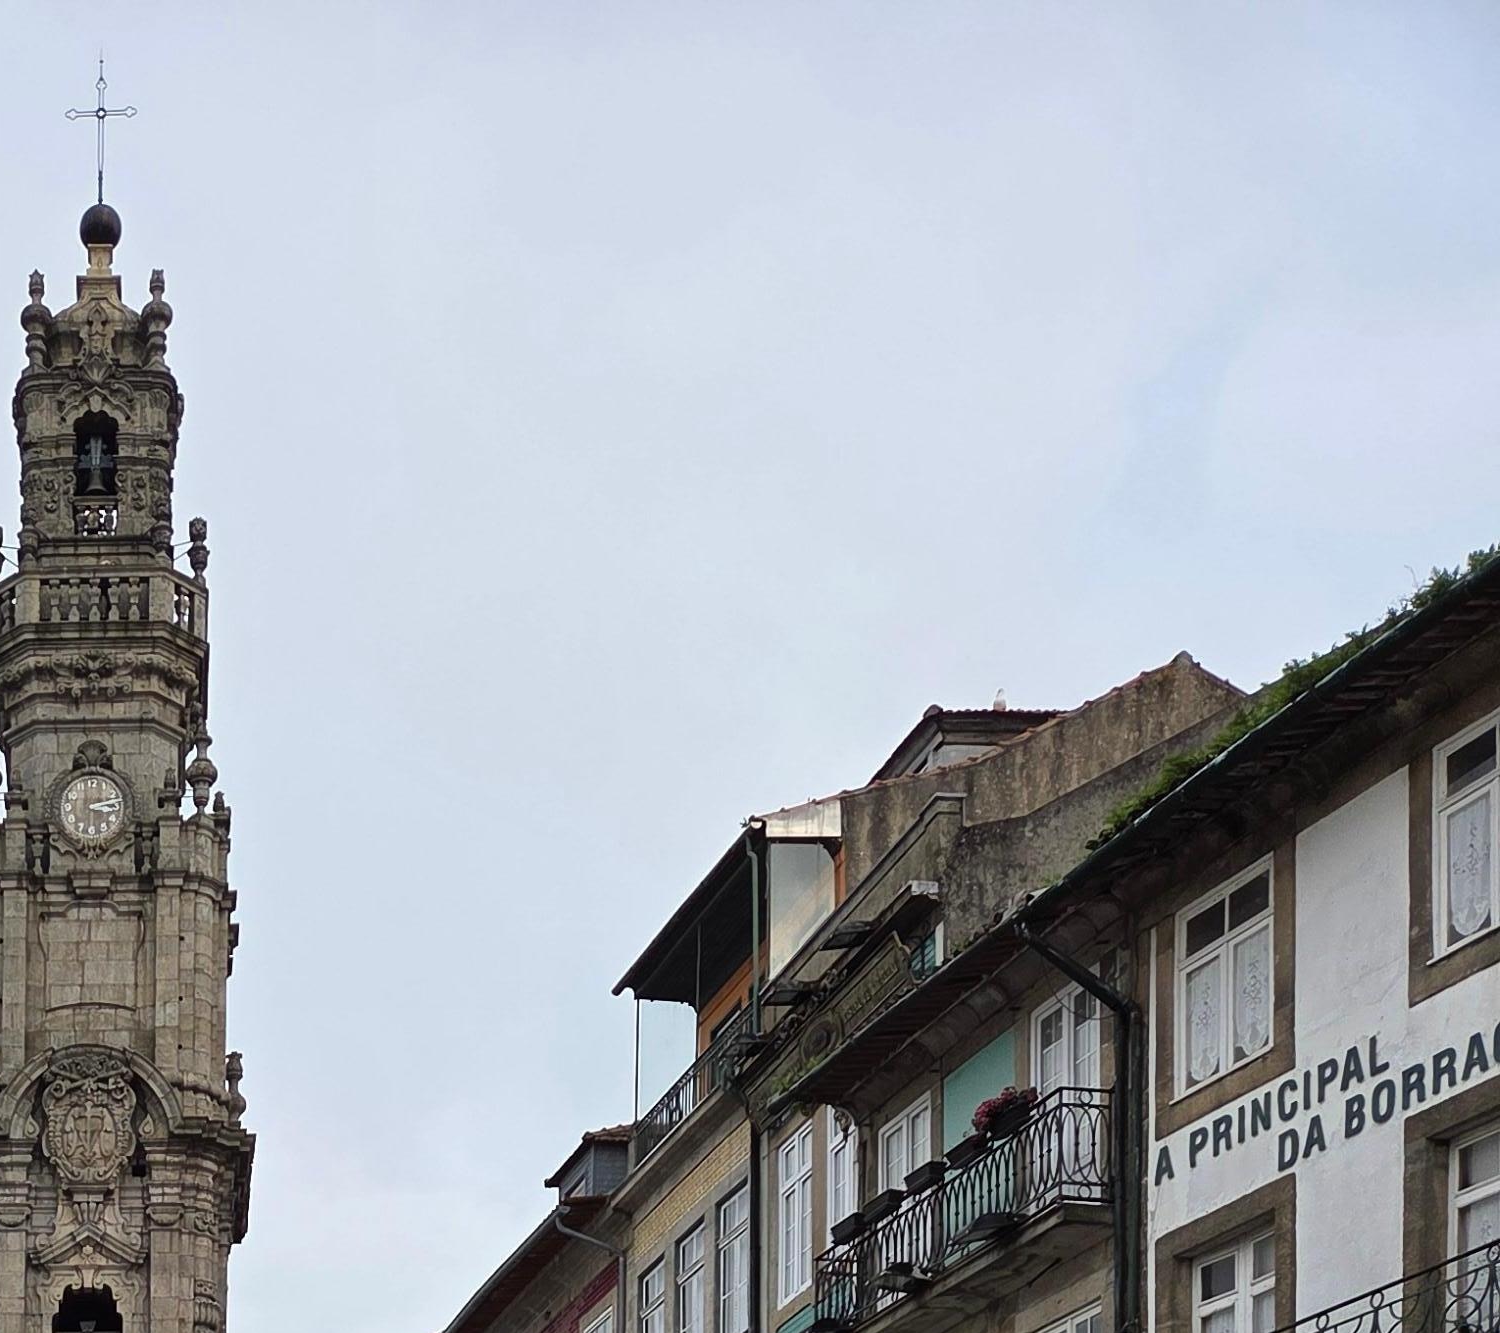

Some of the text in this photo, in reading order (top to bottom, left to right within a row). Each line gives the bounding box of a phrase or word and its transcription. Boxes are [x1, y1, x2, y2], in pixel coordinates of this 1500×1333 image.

[1154, 1034, 1391, 1187] A PRINCIPAL
[1277, 1114, 1328, 1172] DA
